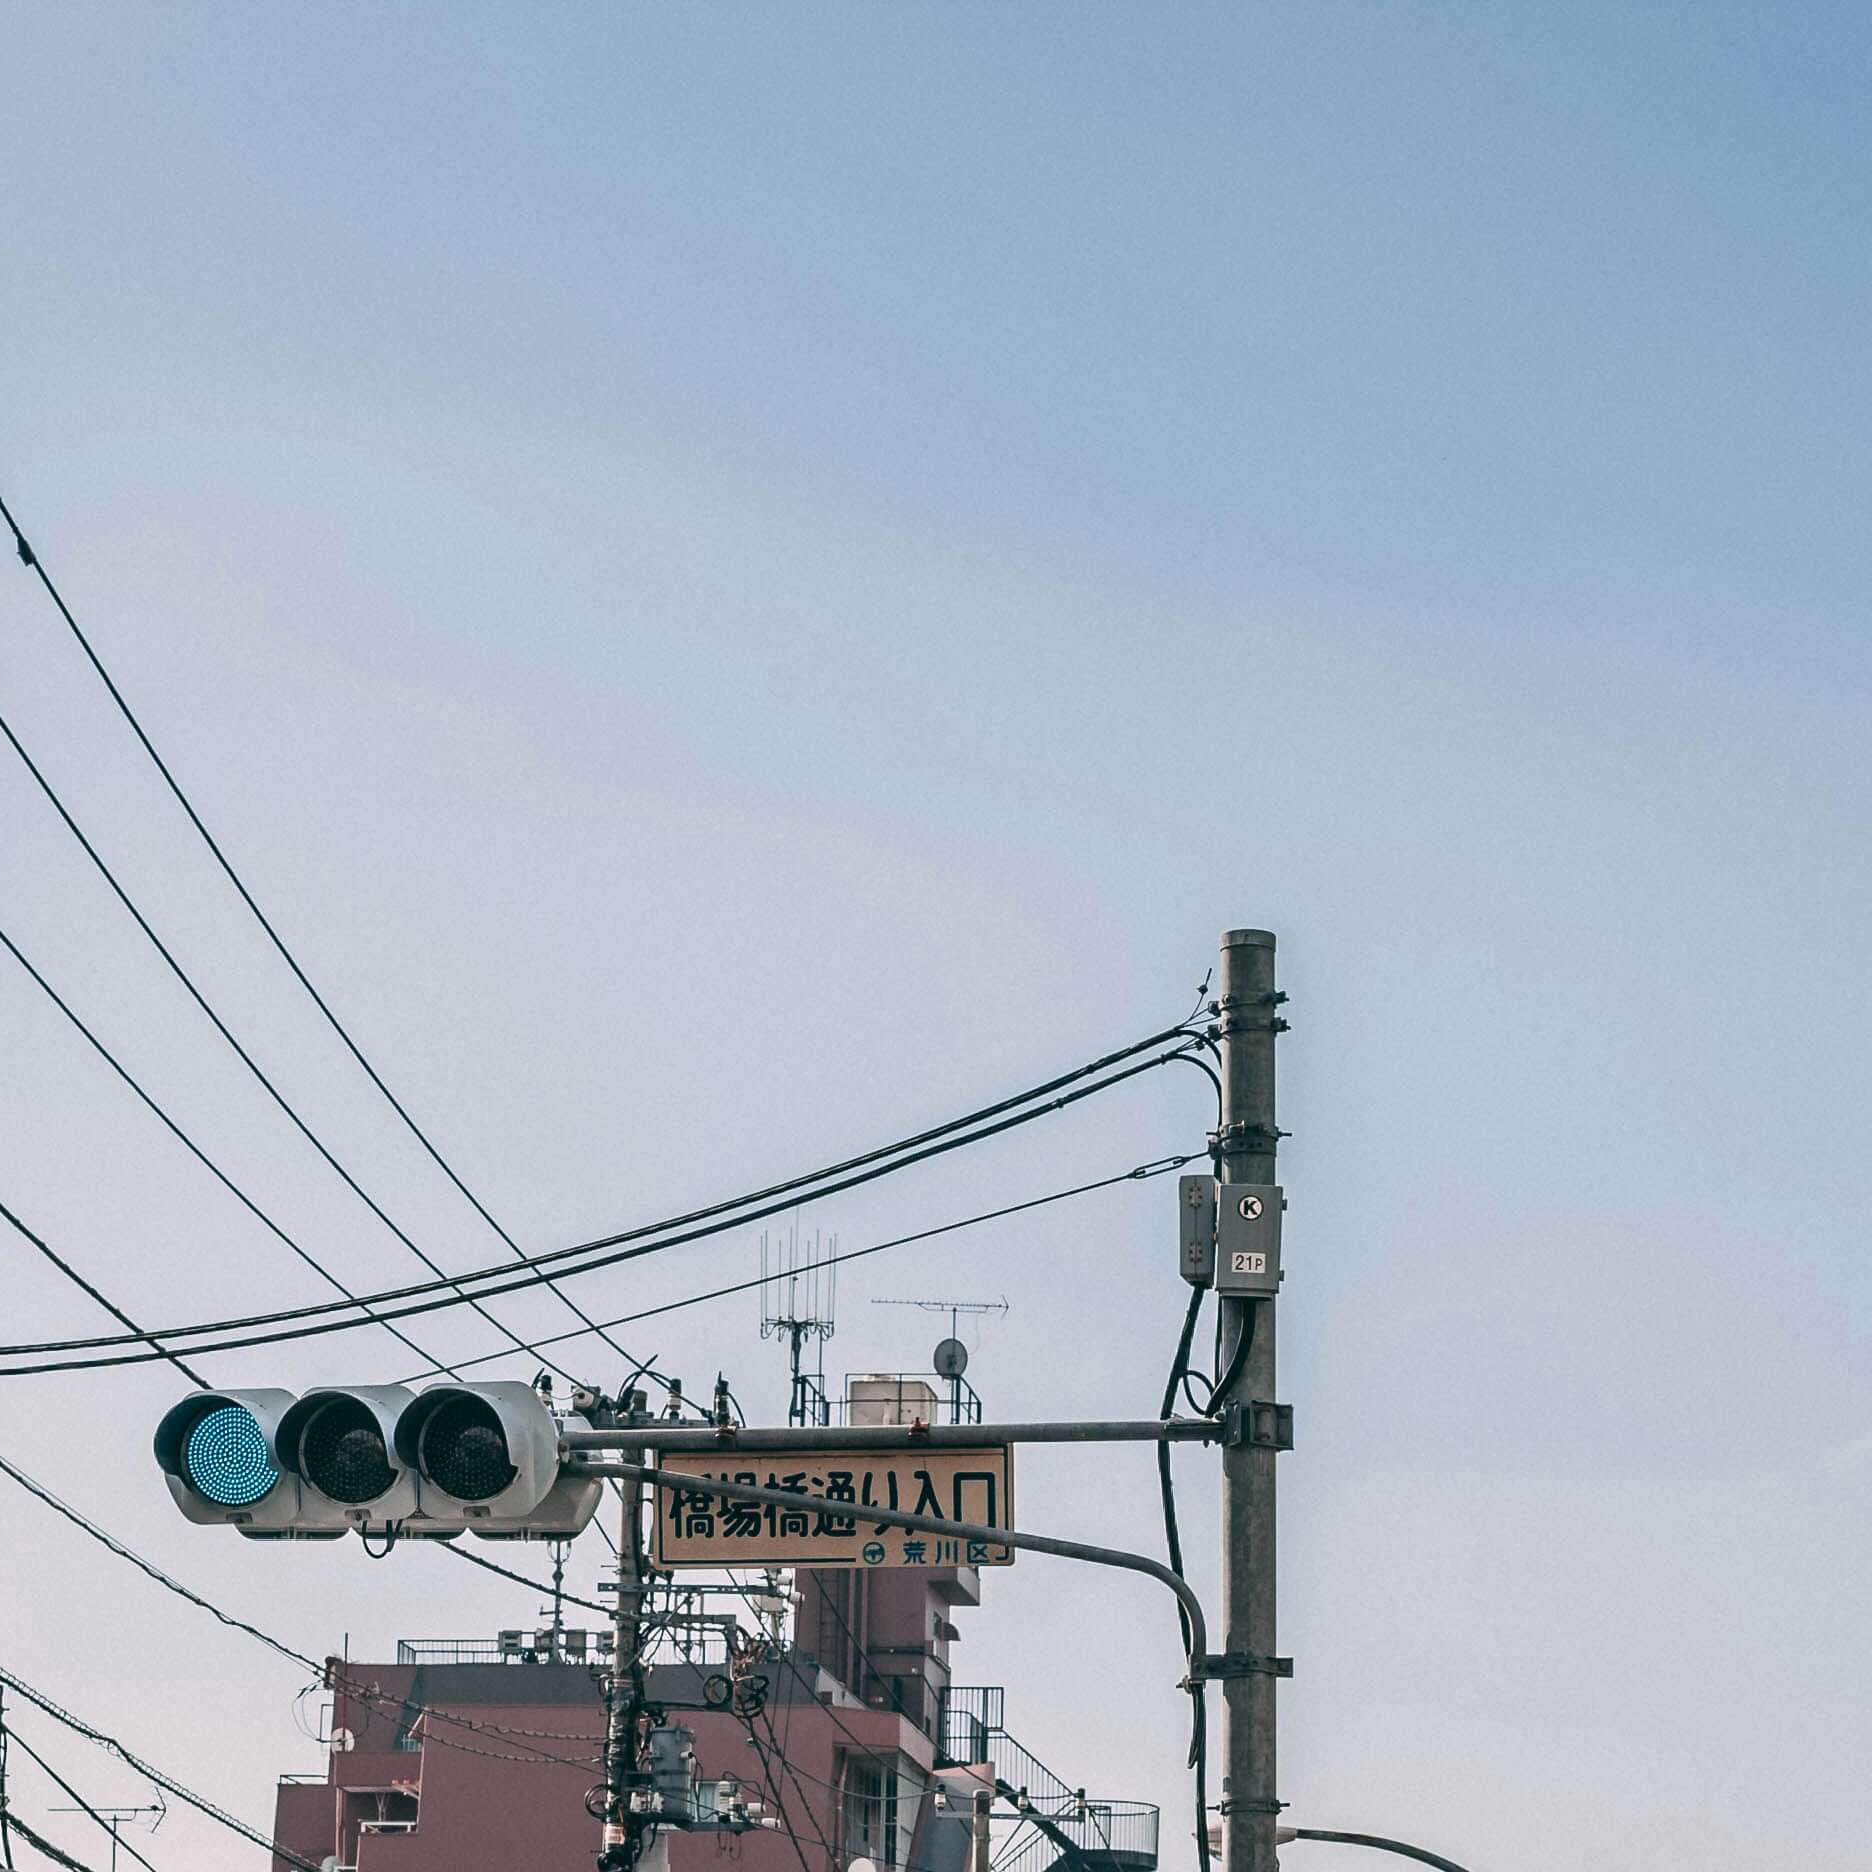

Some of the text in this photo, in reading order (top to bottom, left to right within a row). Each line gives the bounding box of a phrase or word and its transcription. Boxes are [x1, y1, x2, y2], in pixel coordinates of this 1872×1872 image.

[669, 1470, 996, 1539] 橋場橋通り入口
[902, 1540, 991, 1565] 荒川区
